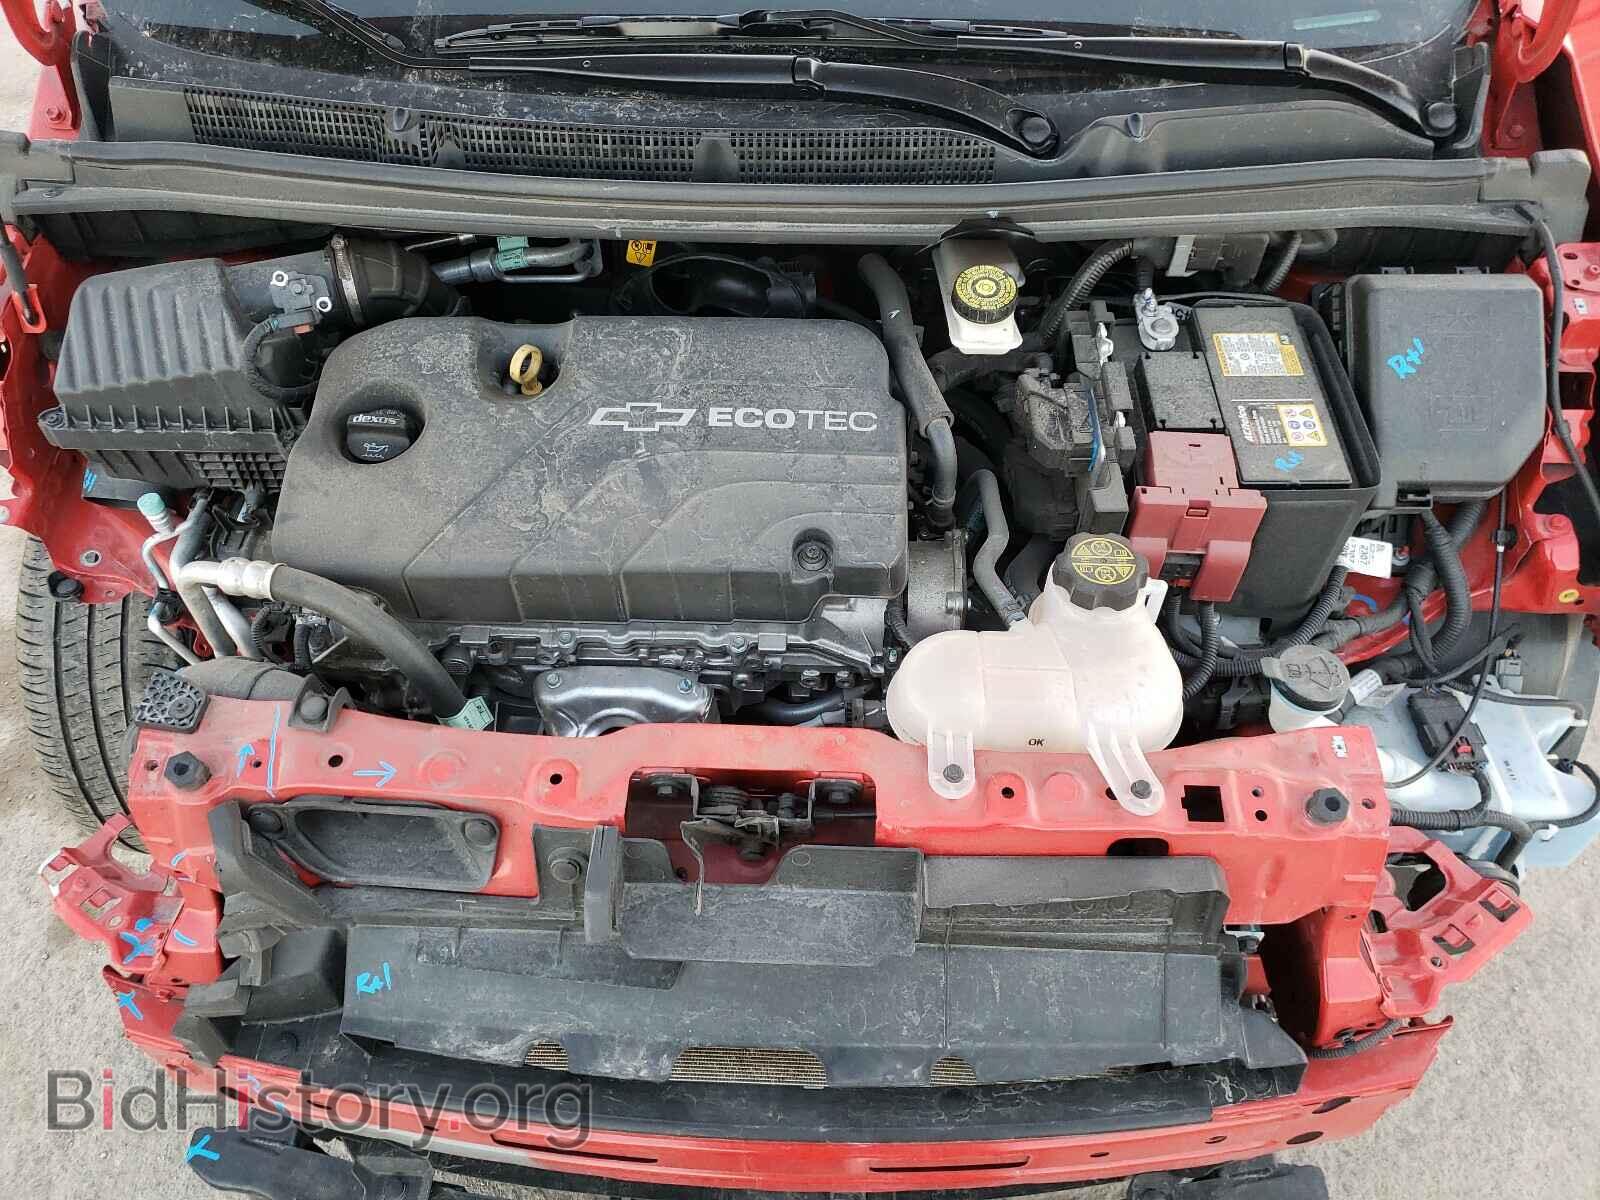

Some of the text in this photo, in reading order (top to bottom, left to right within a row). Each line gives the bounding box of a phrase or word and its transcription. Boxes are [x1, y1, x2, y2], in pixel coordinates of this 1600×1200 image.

[352, 414, 397, 425] dexos
[708, 406, 878, 432] ECOTEC
[1028, 738, 1045, 746] OK
